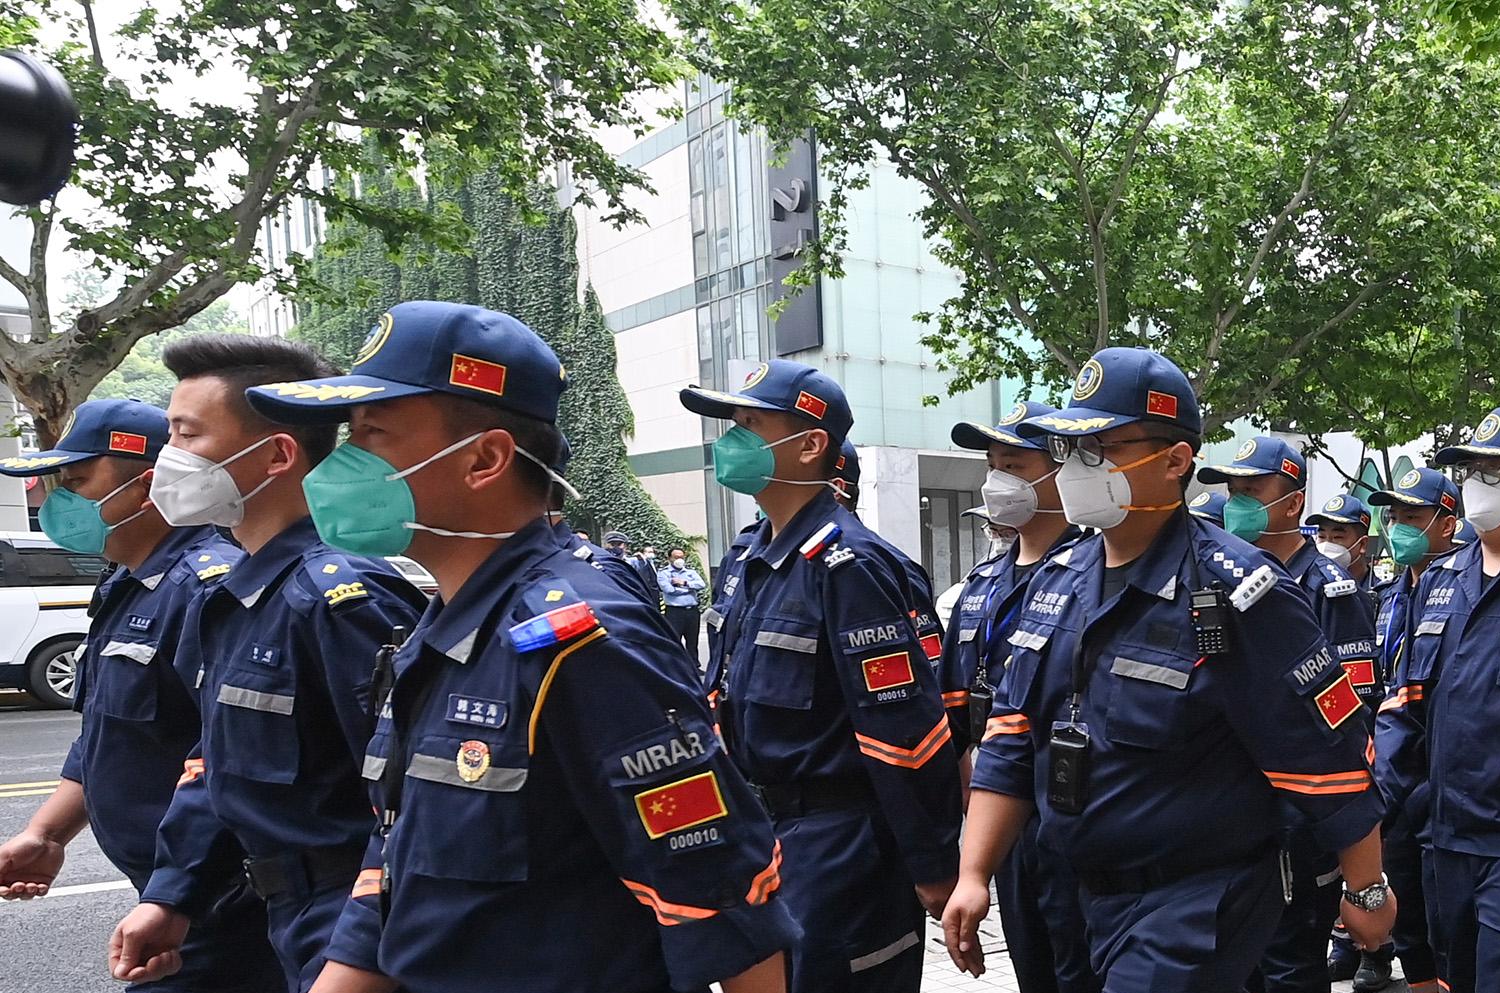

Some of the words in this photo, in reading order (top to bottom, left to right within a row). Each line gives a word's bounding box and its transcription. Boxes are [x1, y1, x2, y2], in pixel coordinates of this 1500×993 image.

[1029, 601, 1062, 615] MRAR
[916, 614, 931, 628] AR
[848, 625, 899, 648] MRAR
[1337, 642, 1372, 656] MRAR
[1293, 647, 1333, 686] MRAR
[877, 689, 907, 701] 000015
[621, 732, 705, 779] MRAR
[669, 827, 719, 850] 000010
